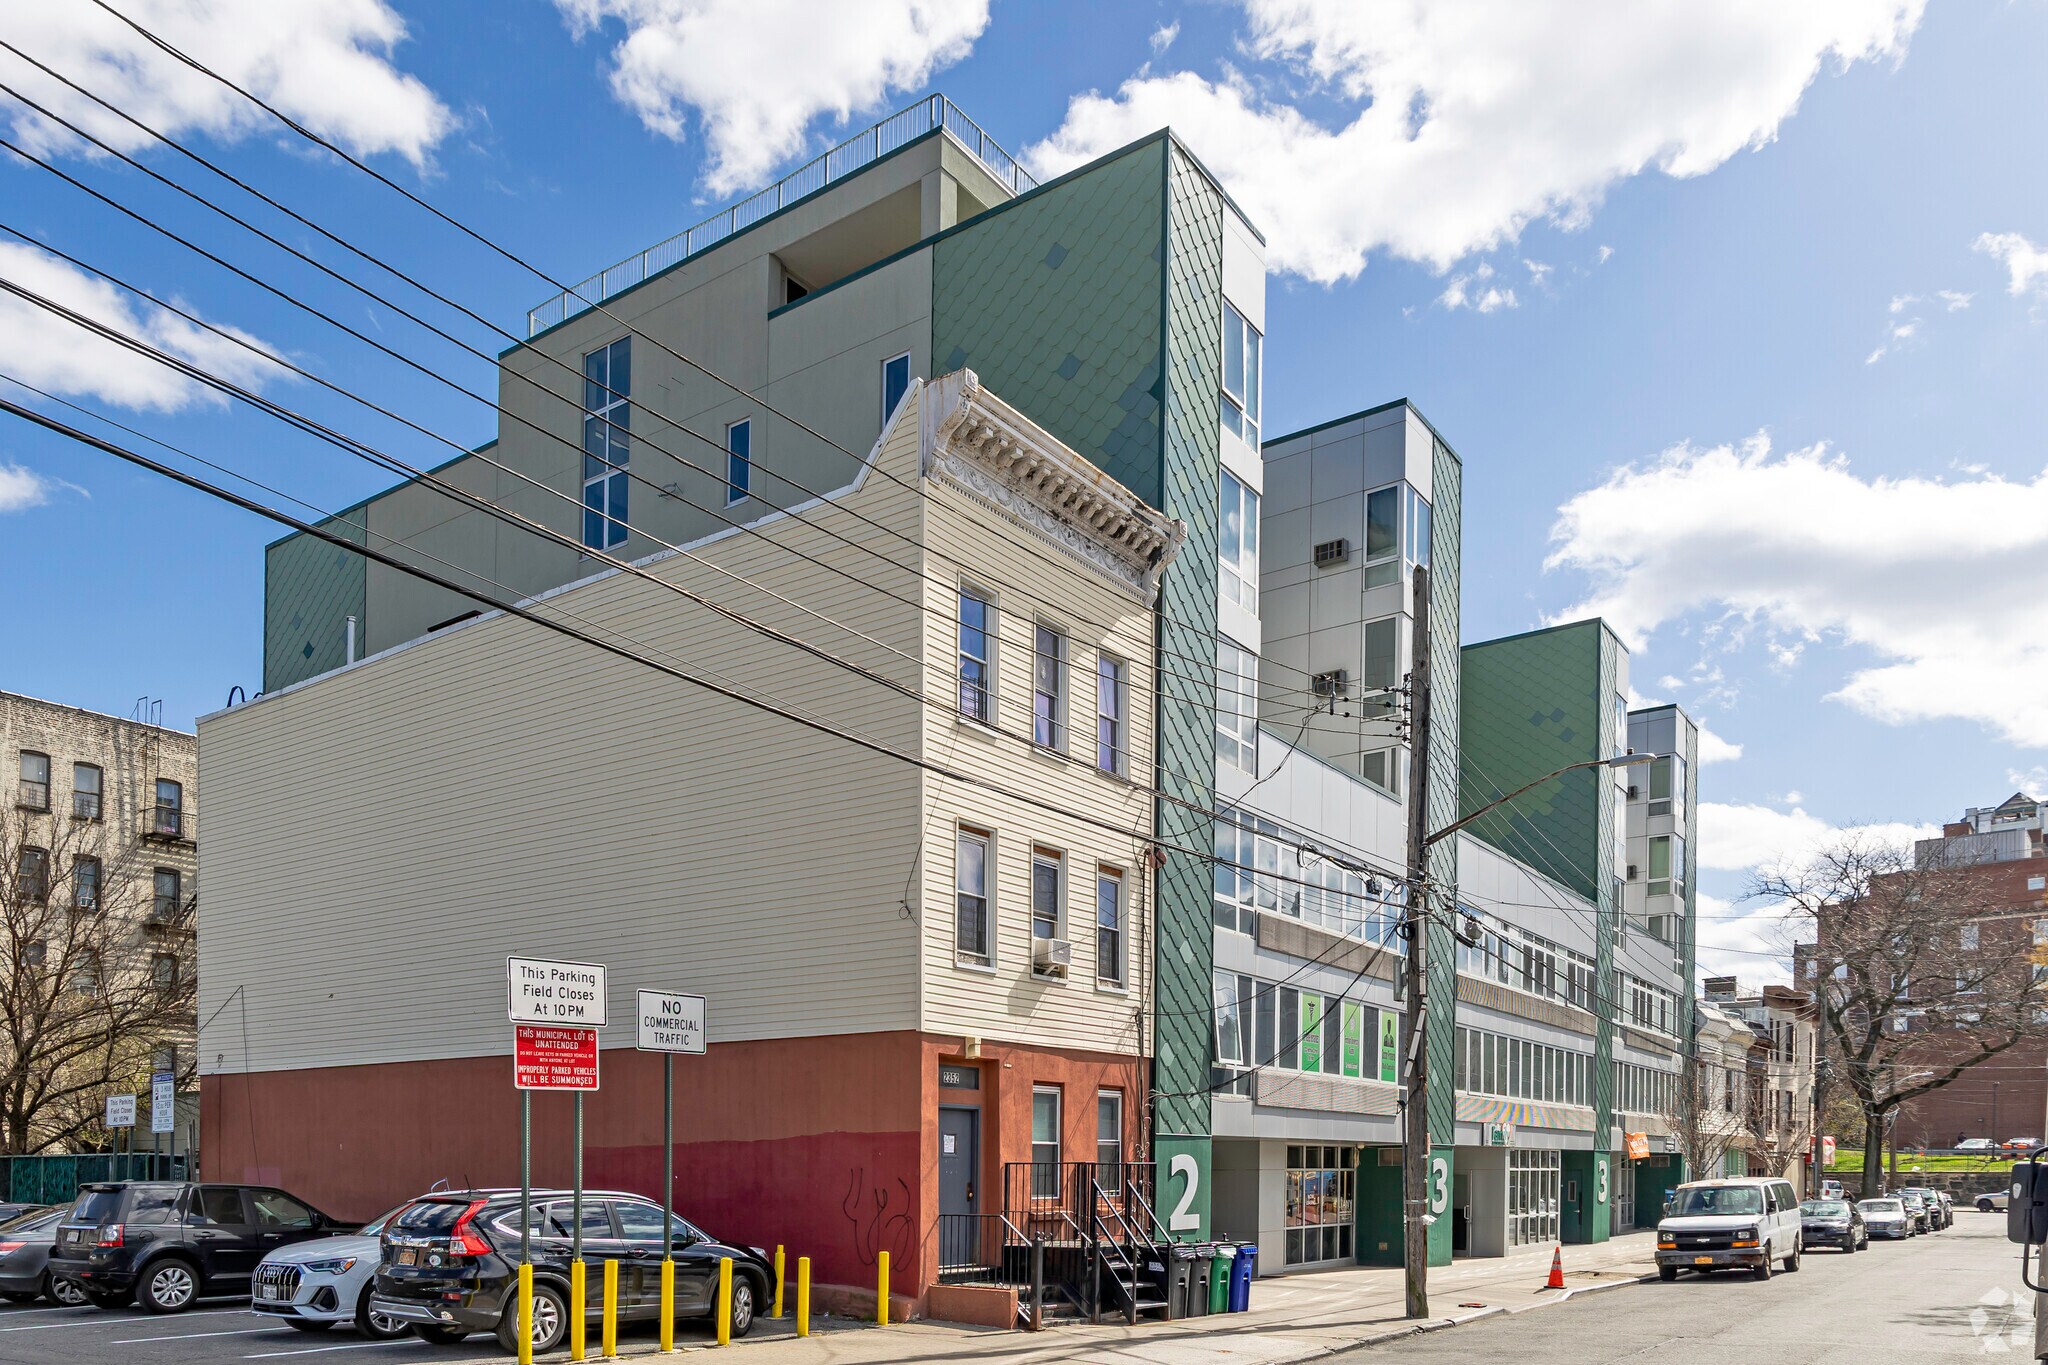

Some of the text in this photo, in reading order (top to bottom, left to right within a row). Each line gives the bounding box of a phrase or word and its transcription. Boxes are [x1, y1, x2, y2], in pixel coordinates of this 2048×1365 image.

[521, 966, 596, 987] This Parking
[523, 984, 594, 1001] Field Closes
[534, 1003, 548, 1015] At
[662, 1000, 681, 1014] NO
[644, 1016, 699, 1031] COMMERCIAL
[519, 1029, 594, 1041] THIS MUNICIPAL LOT IS
[654, 1032, 689, 1045] TRAFFIC
[535, 1040, 579, 1050] UNATTENDED
[518, 1065, 596, 1076] IMPROPERLY PARKED VEHICLES
[522, 1075, 593, 1085] WILL BE SUMMONSED
[943, 1071, 960, 1084] 2352
[1432, 1157, 1448, 1214] 3
[1598, 1160, 1608, 1203] 3
[1170, 1153, 1200, 1231] 2
